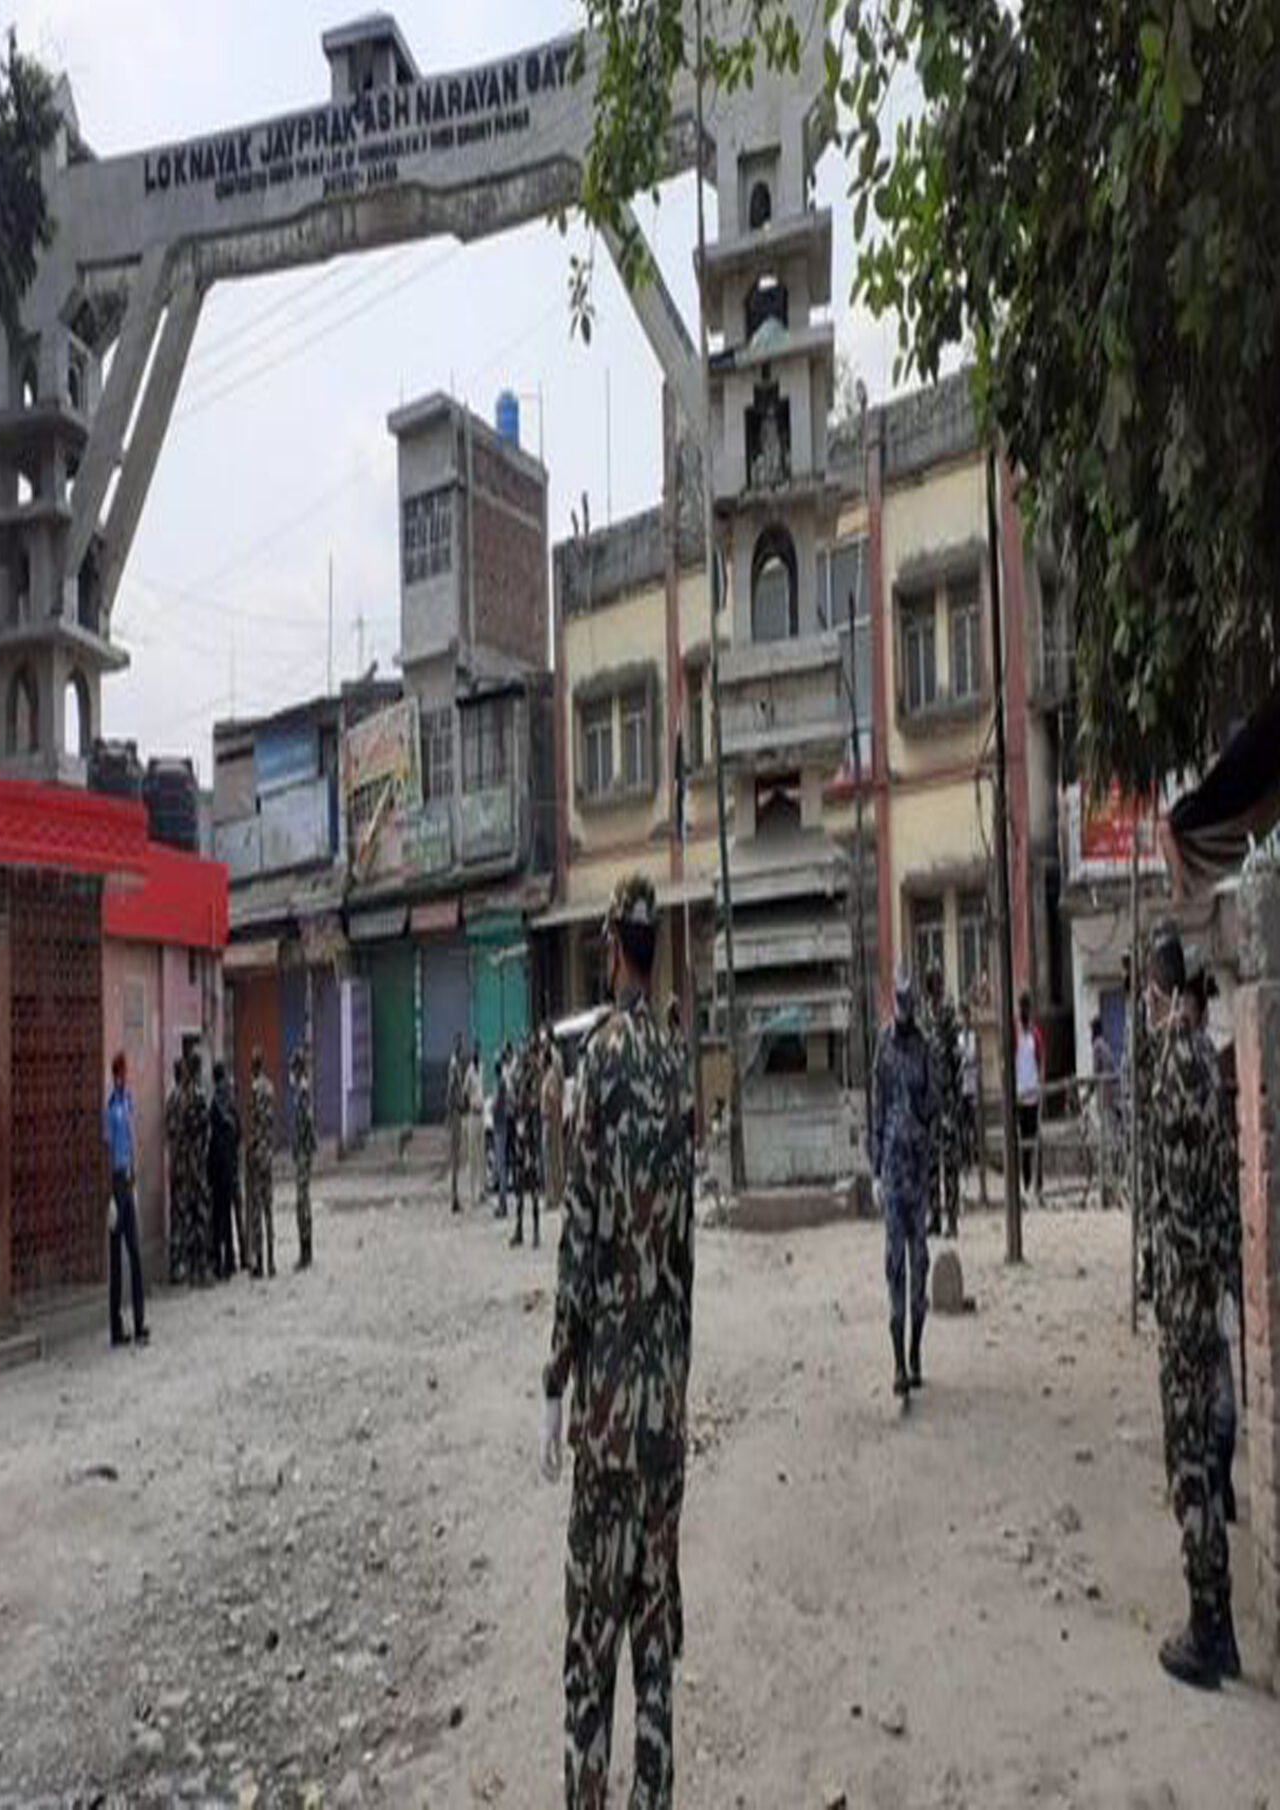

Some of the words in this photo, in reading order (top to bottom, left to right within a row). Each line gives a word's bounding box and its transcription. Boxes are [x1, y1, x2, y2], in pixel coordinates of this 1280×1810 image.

[145, 129, 252, 193] LOKNAYAK
[260, 89, 409, 163] JAYPRAKASH
[417, 62, 519, 123] NARAYAN
[525, 41, 584, 94] GAT
